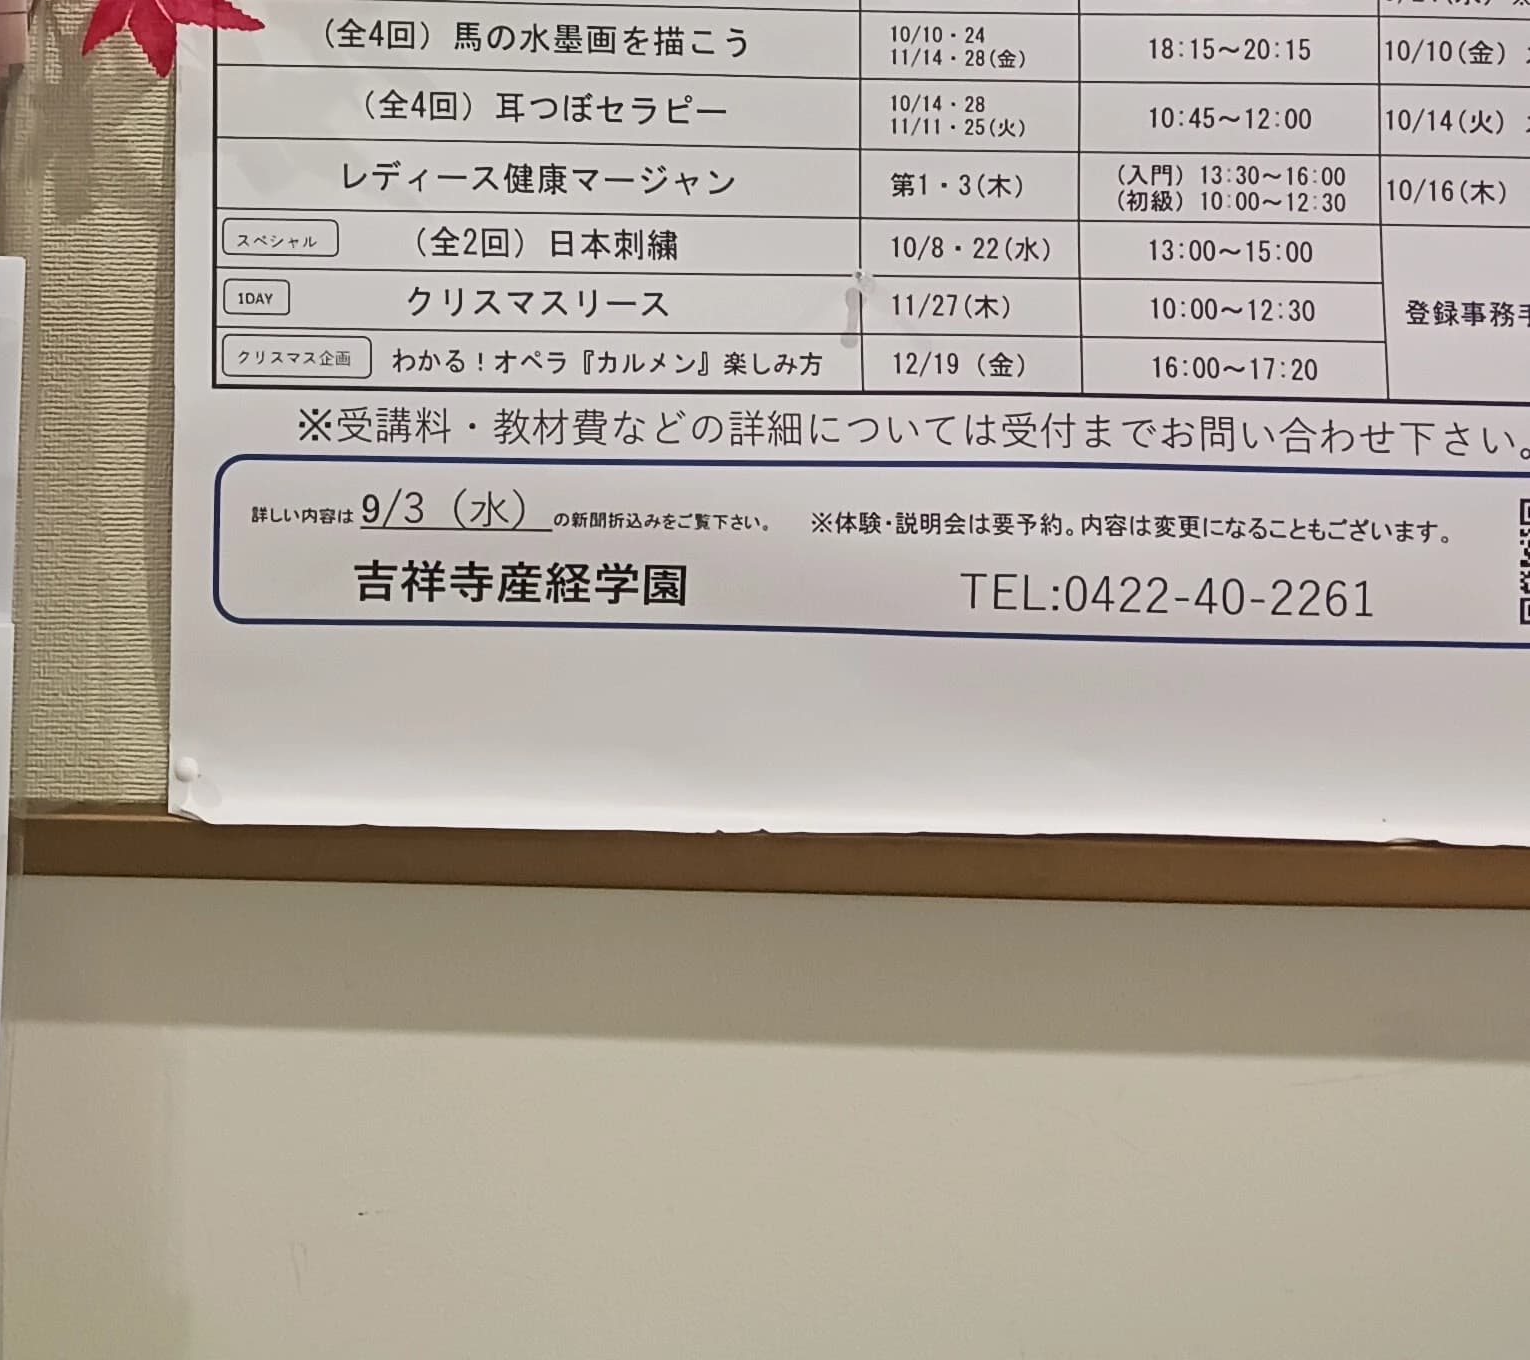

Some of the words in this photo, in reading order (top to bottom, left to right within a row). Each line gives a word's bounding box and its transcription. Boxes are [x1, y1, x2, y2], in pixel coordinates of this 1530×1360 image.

[890, 24, 985, 46] 10/10・24
[891, 47, 1026, 69] 11/14・28(金）
[1384, 38, 1506, 66] 10/10(金）
[890, 93, 986, 115] 10/14・28
[890, 116, 1026, 138] 11/11・25(火）
[1385, 107, 1505, 136] 10/14(火）
[343, 159, 735, 197] レディース健康マージャン
[890, 171, 1023, 199] 第1・3(木）
[1386, 178, 1507, 206] 10/16(木）
[237, 234, 318, 249] スペシャル
[891, 234, 1051, 263] 10/8・22(水）
[237, 292, 274, 305] 1DAY
[407, 285, 669, 319] クリスマスリース
[891, 292, 1011, 320] 11/27(木）
[237, 349, 351, 367] クリスマス企画
[893, 350, 1025, 379] 12/19（金）
[251, 505, 355, 525] 詳しい内容は
[553, 511, 769, 532] の新聞折込みをご覧下さい。
[353, 558, 687, 607] 吉祥寺産経学園
[959, 572, 1374, 618] TEL:0422-40-2261
